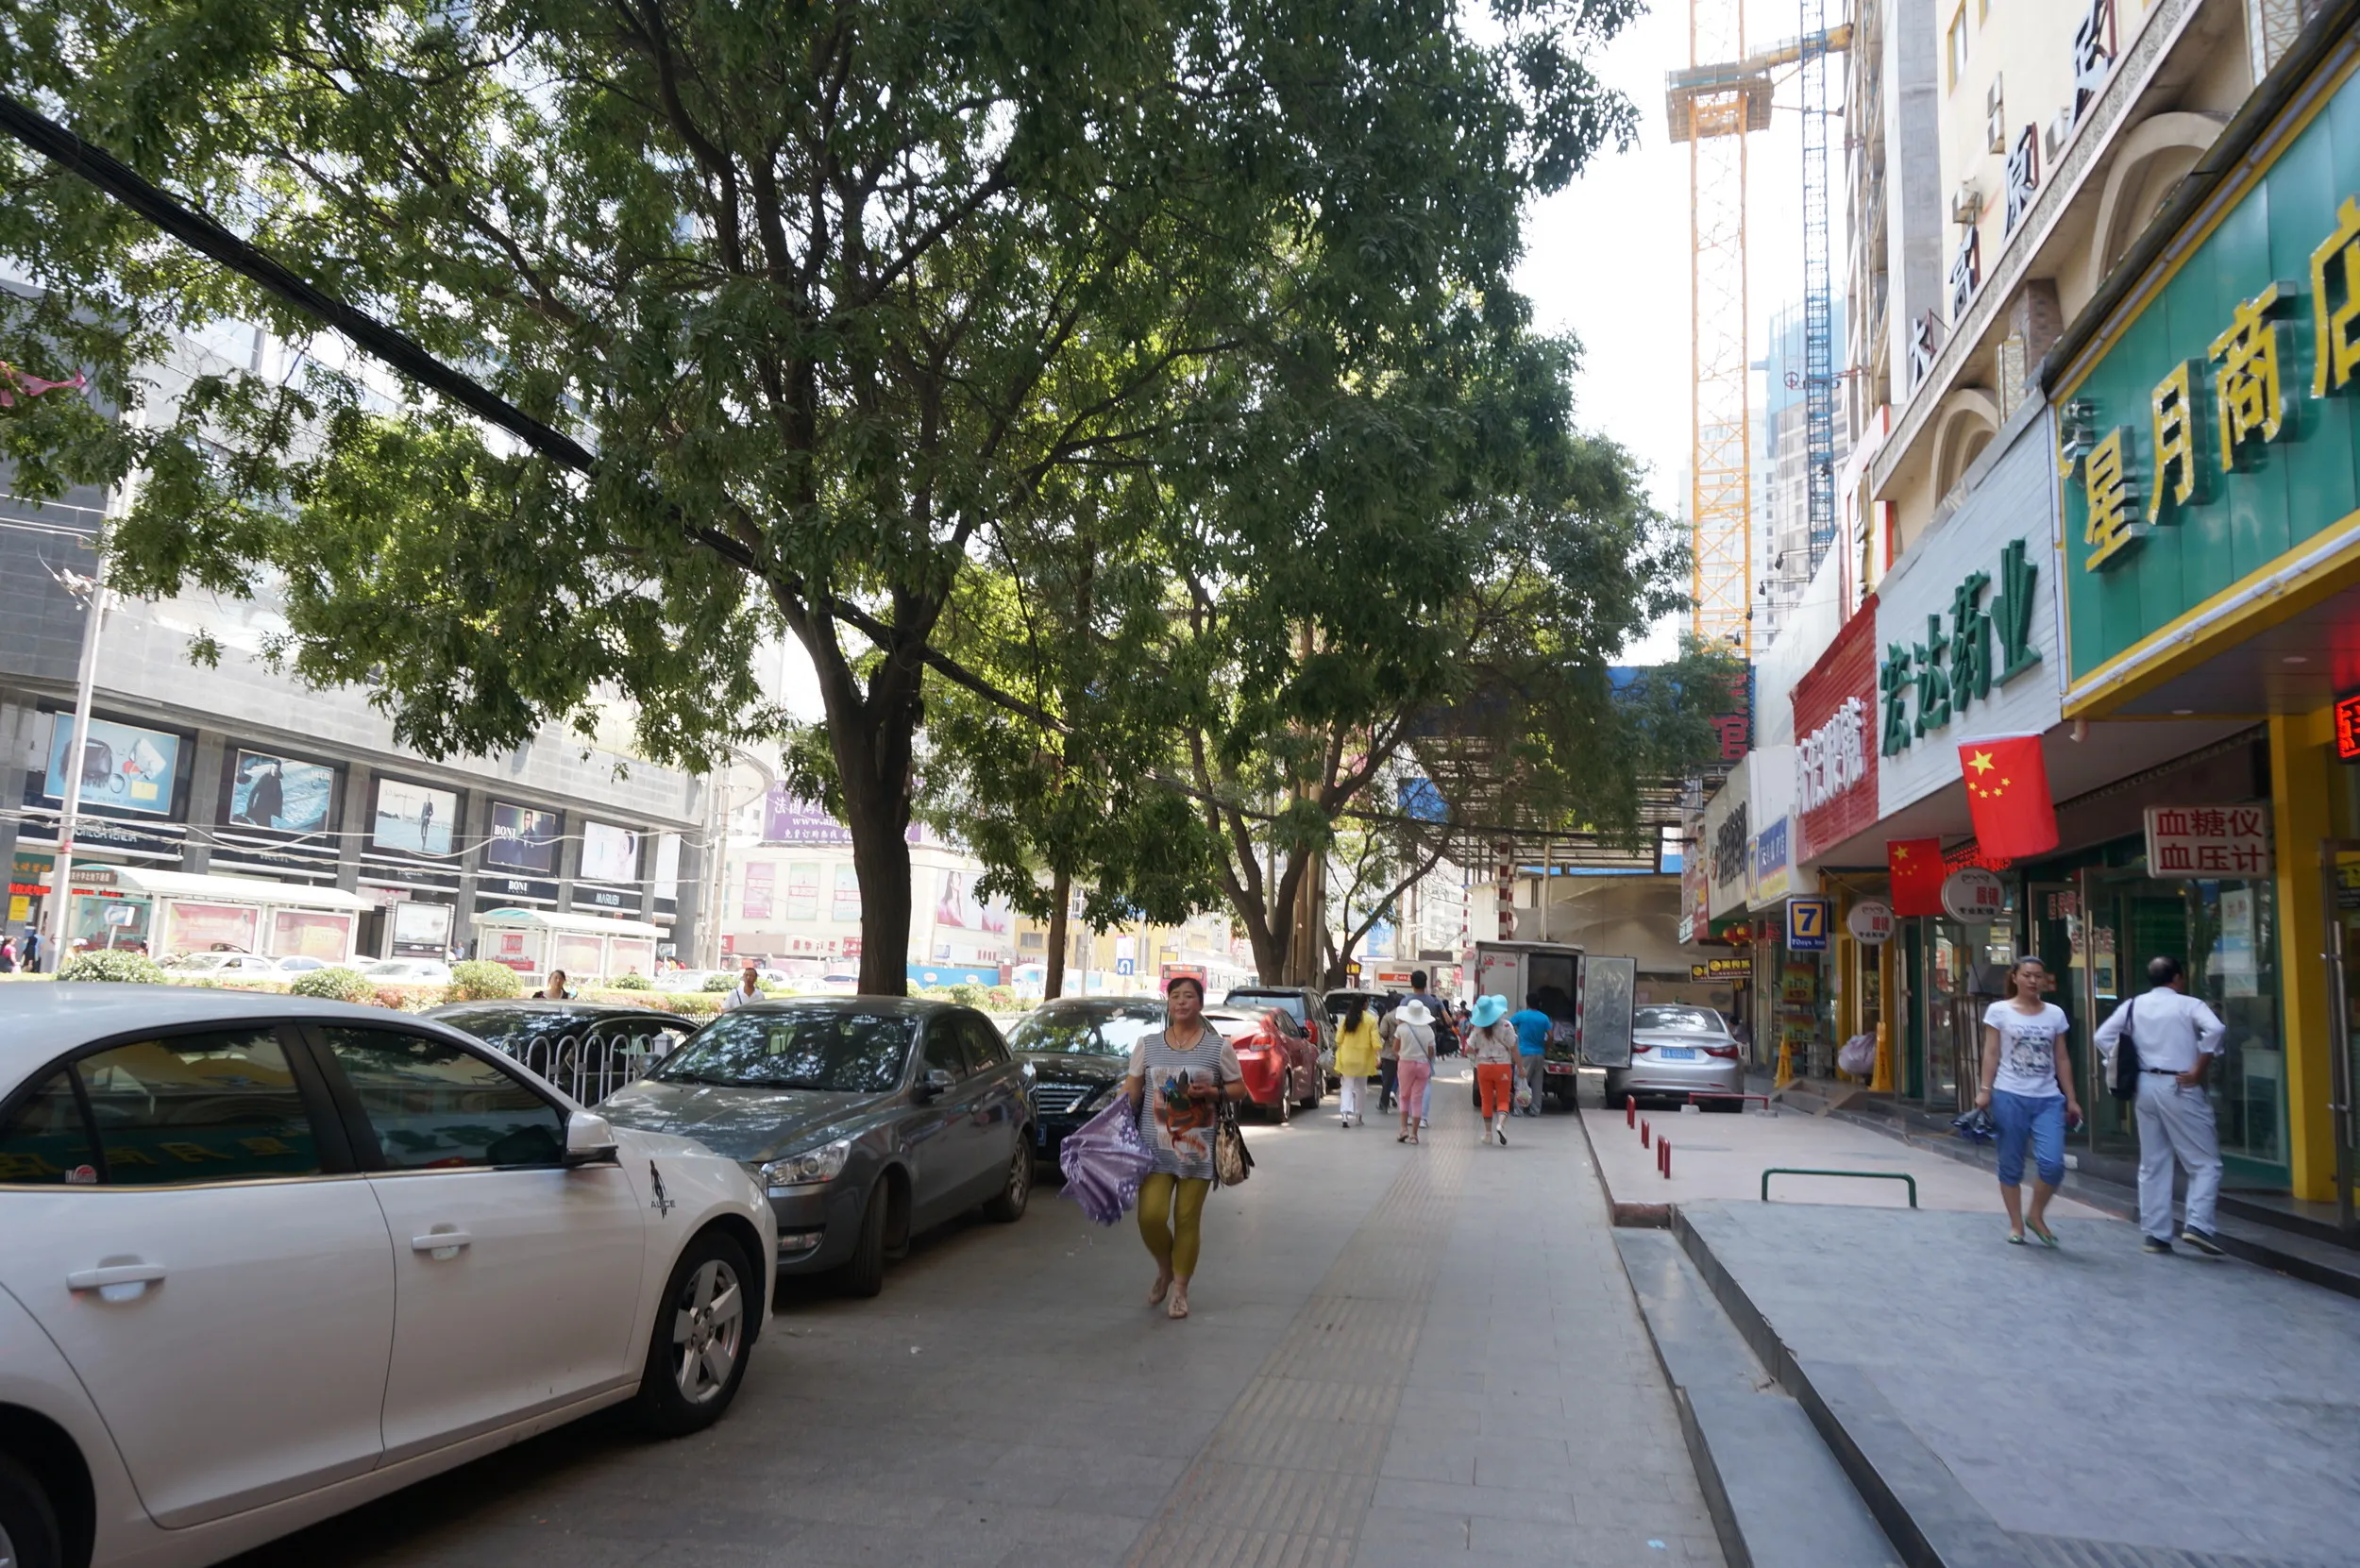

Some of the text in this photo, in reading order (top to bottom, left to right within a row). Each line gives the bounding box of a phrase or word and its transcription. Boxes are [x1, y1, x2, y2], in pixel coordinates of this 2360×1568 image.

[493, 823, 517, 839] BONI
[2156, 808, 2264, 838] 血糖仪
[2159, 843, 2266, 872] 血压计
[508, 880, 528, 892] BONI
[1797, 908, 1817, 933] 7
